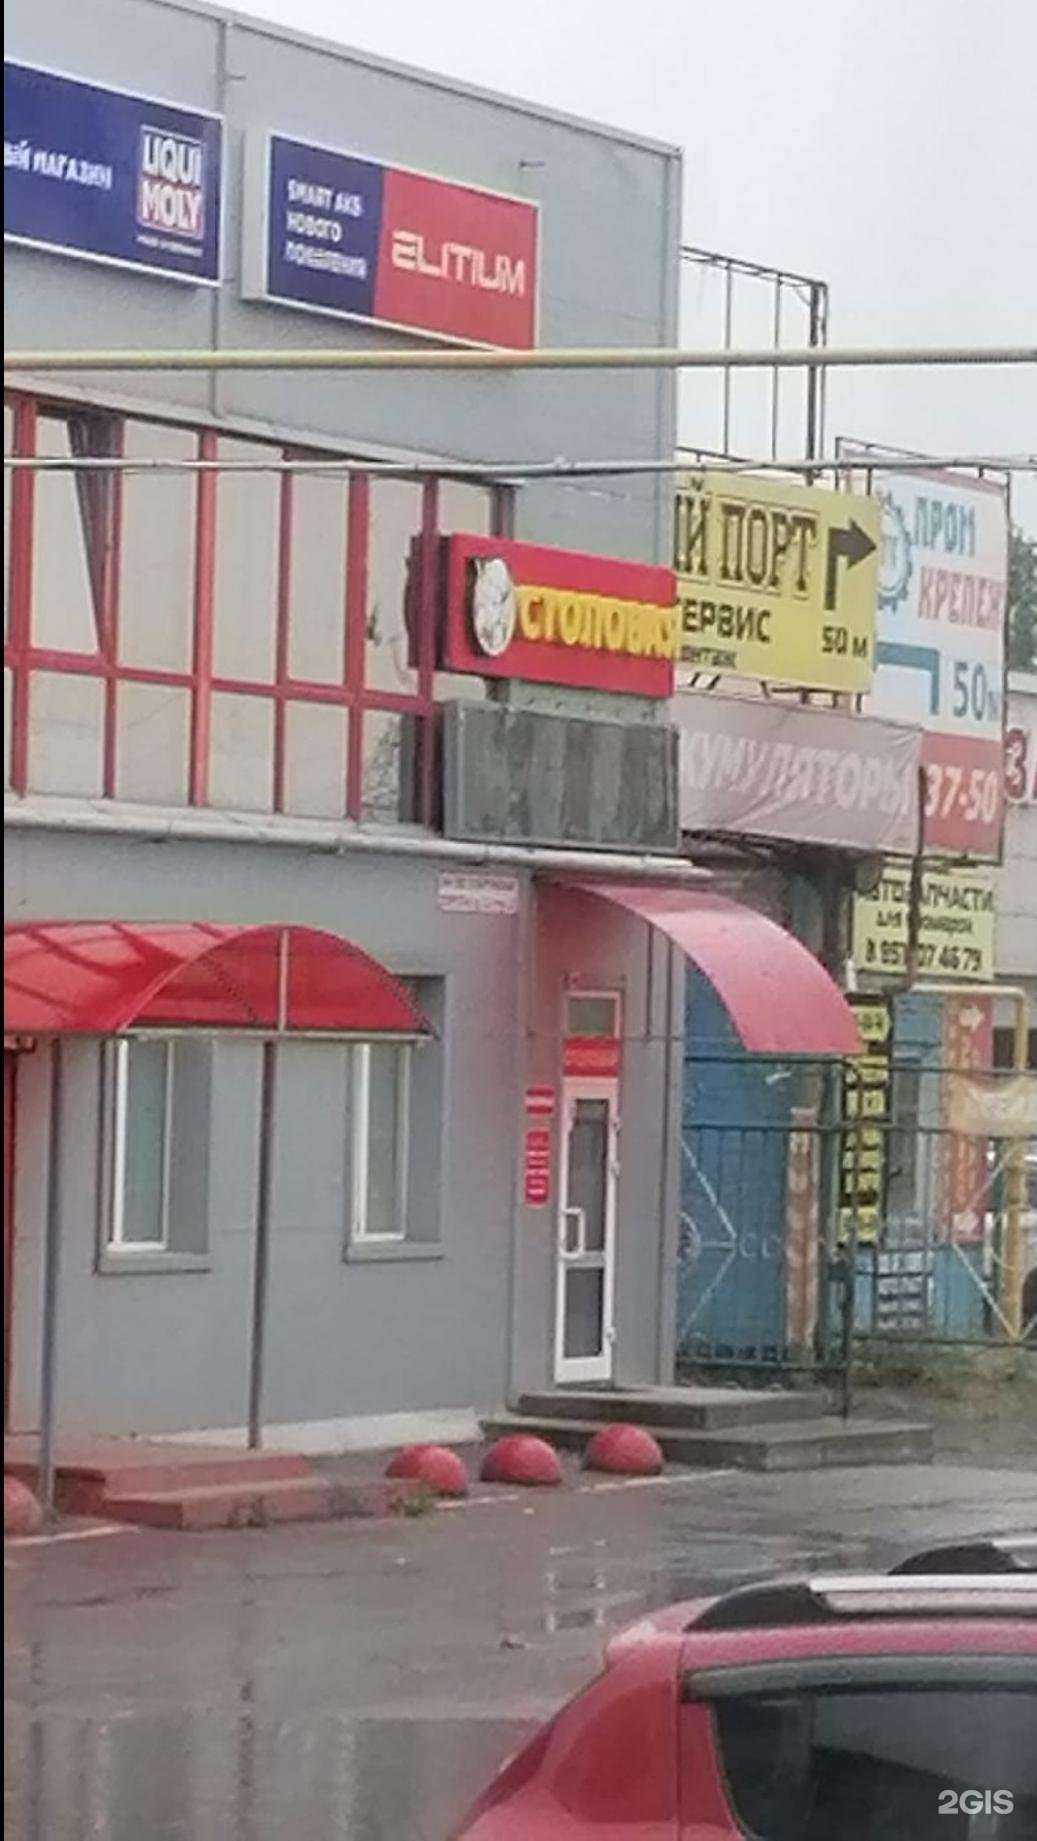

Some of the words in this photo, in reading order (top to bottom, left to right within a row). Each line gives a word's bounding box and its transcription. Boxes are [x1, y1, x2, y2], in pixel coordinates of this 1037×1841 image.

[144, 134, 201, 185] LIQUI
[141, 180, 201, 229] MOLY
[391, 229, 526, 296] ELITIUM
[721, 500, 818, 592] ПОРТ
[915, 496, 976, 558] ПРОМ
[680, 598, 771, 643] ЕРВИС
[822, 626, 848, 655] 50
